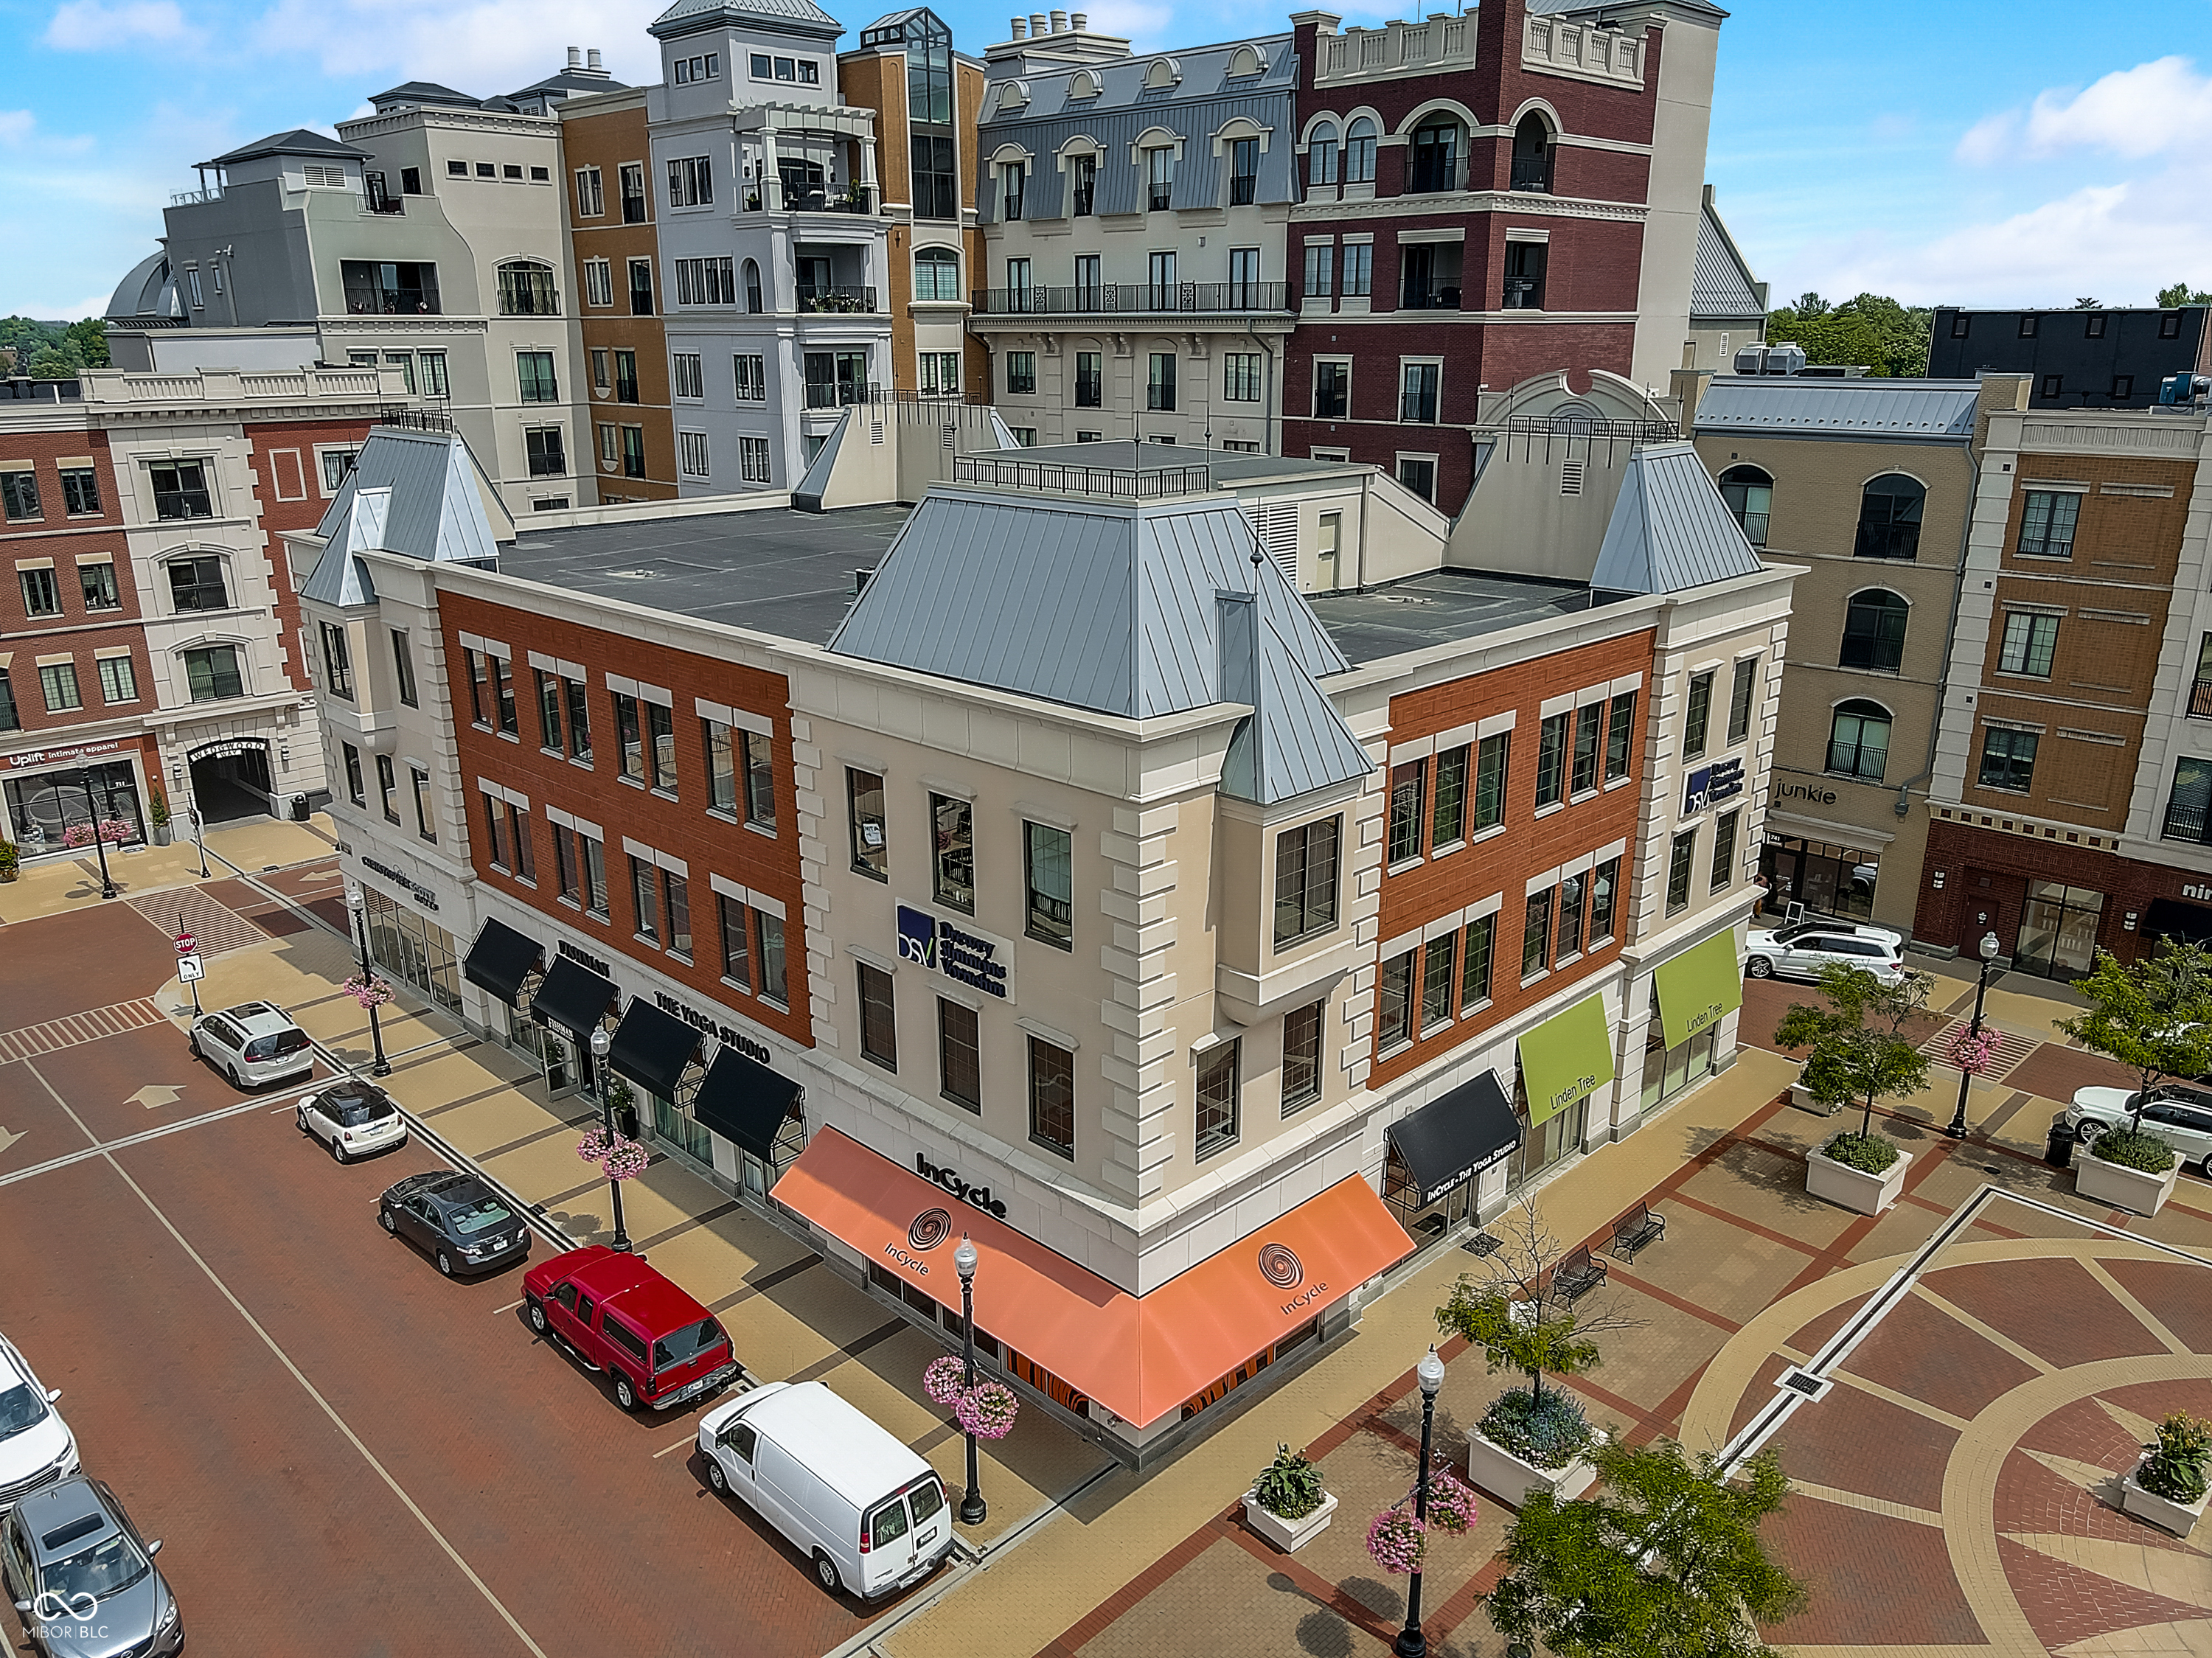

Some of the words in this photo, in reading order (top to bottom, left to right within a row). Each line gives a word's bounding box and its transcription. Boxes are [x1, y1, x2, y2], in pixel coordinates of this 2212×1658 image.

[9, 752, 46, 767] Uplift
[48, 748, 84, 759] intimate
[86, 742, 119, 754] apparel
[192, 742, 262, 760] WEDGWOOD
[1774, 778, 1837, 805] junkie
[175, 937, 195, 949] STOP
[899, 933, 934, 966] DSV
[939, 922, 995, 959] Drewry
[939, 940, 1007, 979] Simmons
[940, 958, 1007, 998] Vornehm
[547, 1016, 574, 1038] FISHMAN
[654, 990, 681, 1017] THE
[680, 1003, 719, 1038] YOGA
[719, 1025, 770, 1064] STUDIO
[1687, 1013, 1708, 1033] Linden
[1708, 1003, 1723, 1018] Tree
[1550, 1086, 1577, 1110] Linden
[1576, 1074, 1596, 1093] Tree
[917, 1152, 1006, 1219] InCycle
[884, 1242, 929, 1275] InCycle
[1280, 1282, 1329, 1315] InCycle
